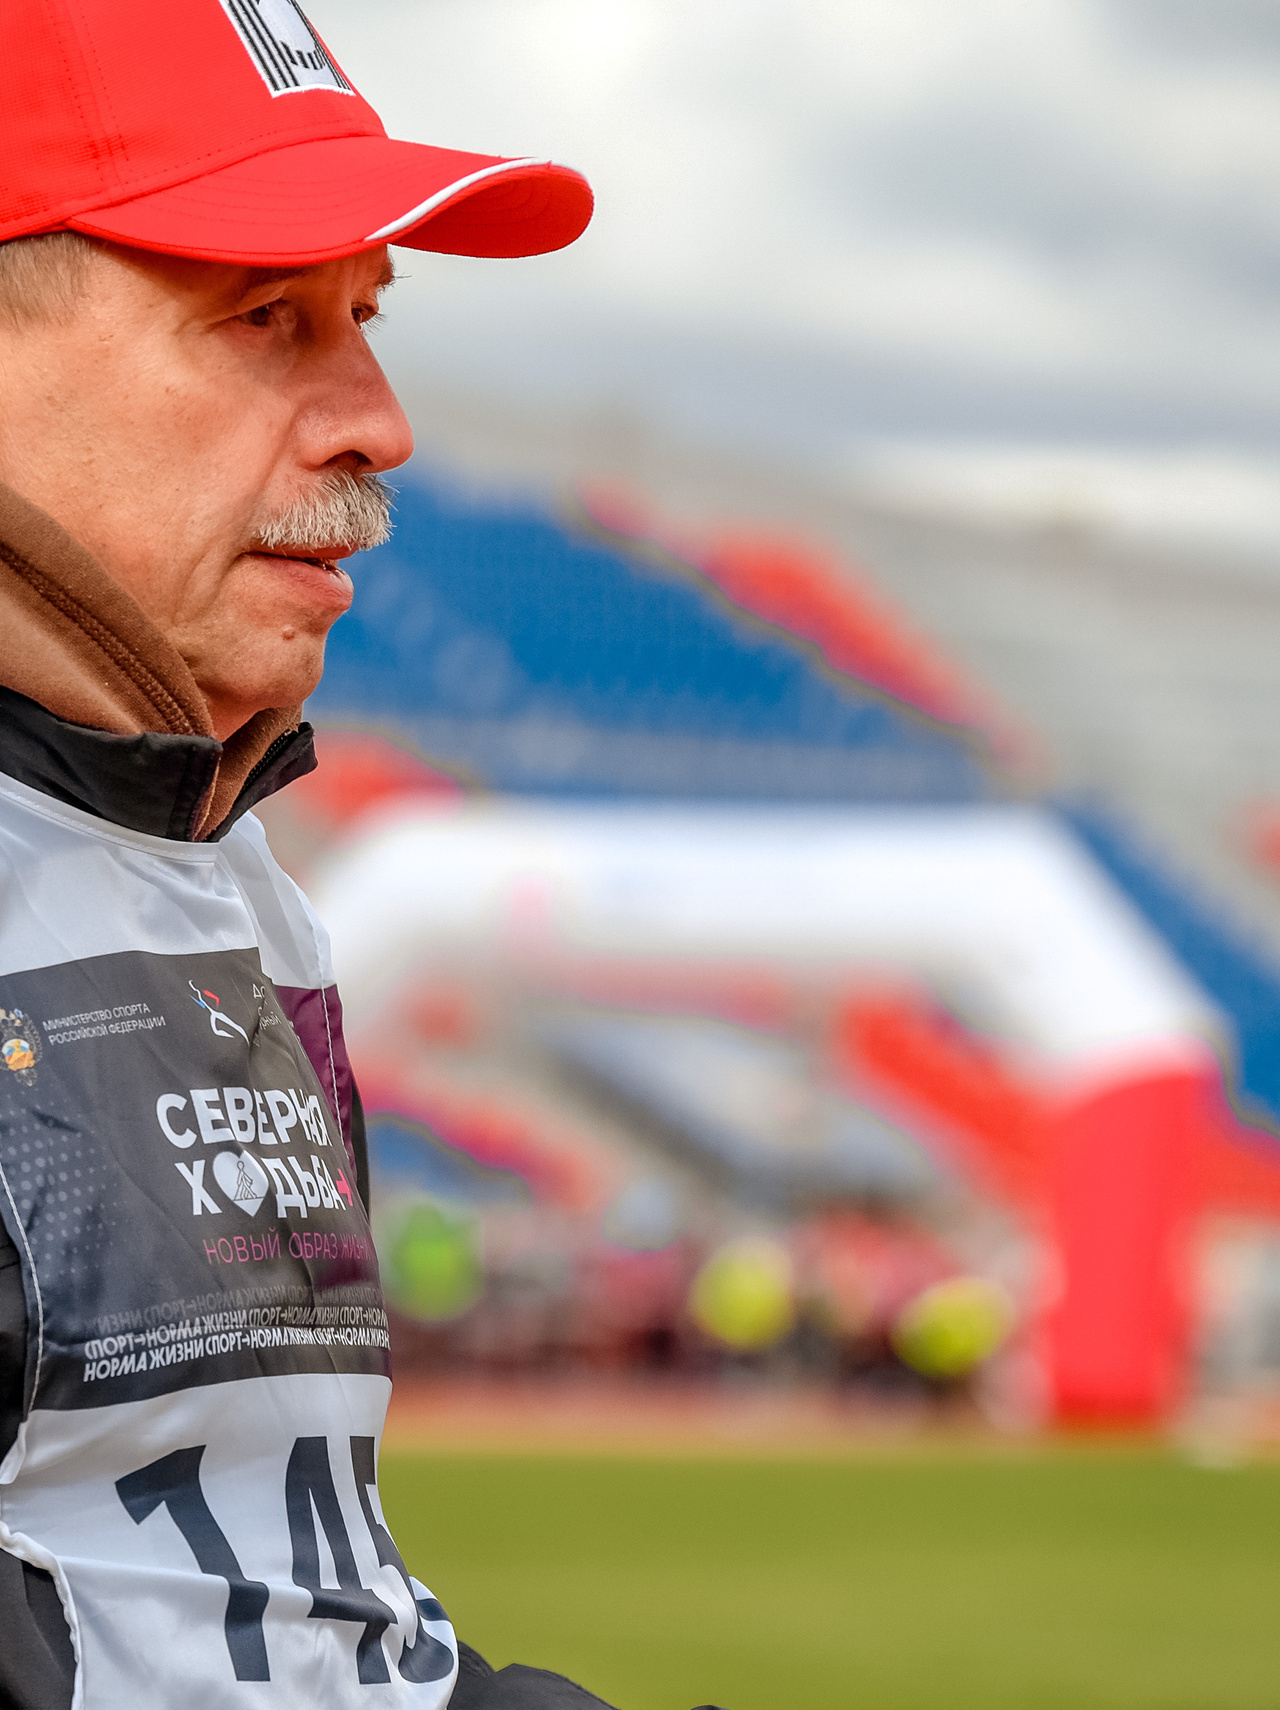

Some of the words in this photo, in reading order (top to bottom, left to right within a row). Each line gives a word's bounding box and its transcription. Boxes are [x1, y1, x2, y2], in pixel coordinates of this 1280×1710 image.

[42, 1009, 112, 1031] МИНИСТЕРСТВО
[112, 1003, 151, 1018] СПОРТА
[48, 1023, 108, 1045] РОССИЙСКОЙ
[108, 1015, 166, 1034] ФЕДЕРАЦИИ
[202, 1227, 281, 1264] НОВЫЙ
[288, 1232, 338, 1260] ОБРАЗ
[84, 1331, 134, 1360] СПОРТ
[145, 1317, 201, 1348] НОРМА
[201, 1308, 248, 1335] ЖИЗНИ
[248, 1306, 282, 1326] СПОРТ
[339, 1306, 363, 1325] СПОРТ
[83, 1351, 147, 1382] НОРМА
[148, 1338, 204, 1370] ЖИЗНИ
[205, 1331, 242, 1356] СПОРТ
[250, 1327, 290, 1349] НОРМА
